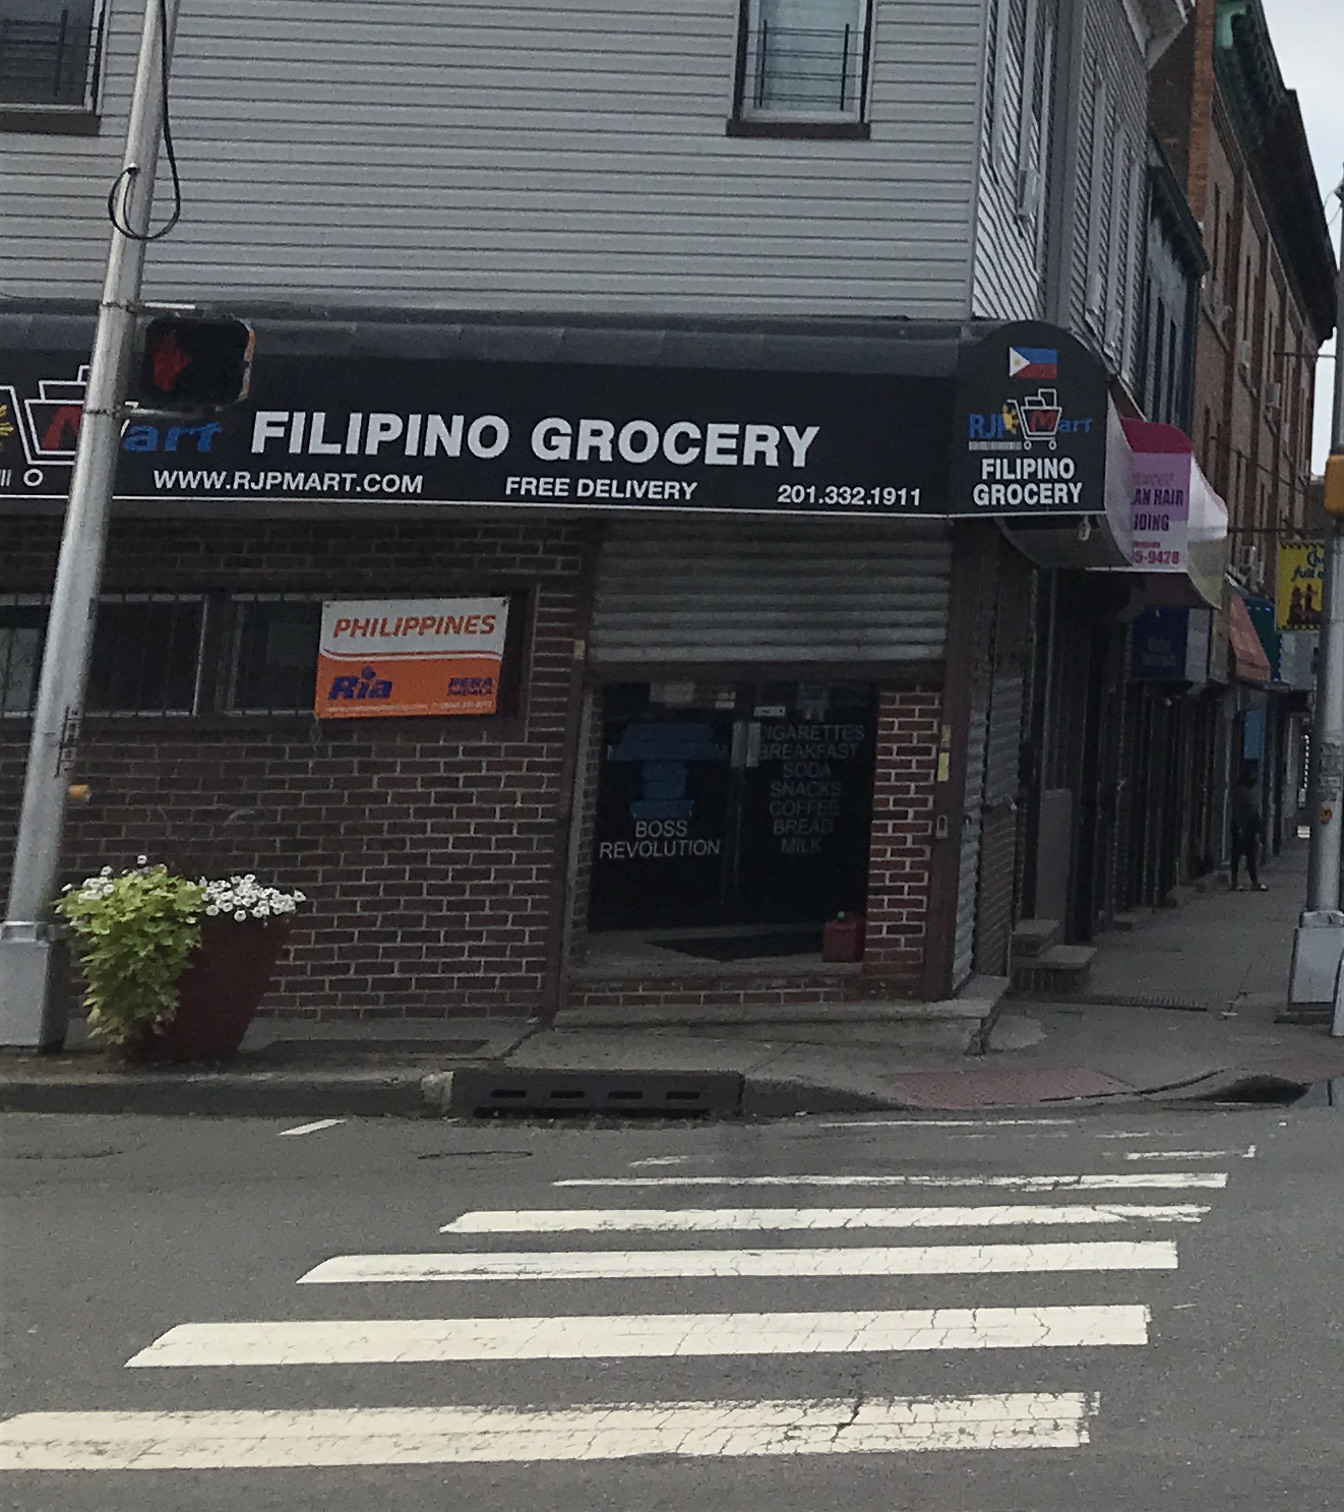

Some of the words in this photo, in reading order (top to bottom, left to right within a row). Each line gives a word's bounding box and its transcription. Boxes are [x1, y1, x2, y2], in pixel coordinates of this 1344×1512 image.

[251, 410, 510, 459] FILIPINO
[531, 416, 820, 468] GROCERY
[981, 457, 1075, 481] FILIPINO
[153, 470, 423, 494] WWW.RJPMART.COM
[505, 476, 570, 497] FREE
[577, 478, 698, 500] DELIVERY
[777, 484, 921, 506] 201.332.1911
[972, 482, 1083, 506] GROCERY
[1132, 488, 1152, 505] AN
[1153, 488, 1184, 507] HAIR
[1134, 512, 1170, 531] IDING
[1133, 550, 1180, 565] 5-9428
[333, 614, 497, 638] PHILIPPINES
[328, 665, 393, 701] Ria
[758, 743, 860, 760] BREAKFAST
[783, 762, 832, 779] SODA
[770, 781, 842, 799] SNACKS
[769, 801, 841, 817] COFFEE
[635, 820, 688, 839] BOSS
[773, 819, 834, 836] BREAD
[600, 839, 721, 859] REVOLUTION
[781, 838, 822, 854] MILK
